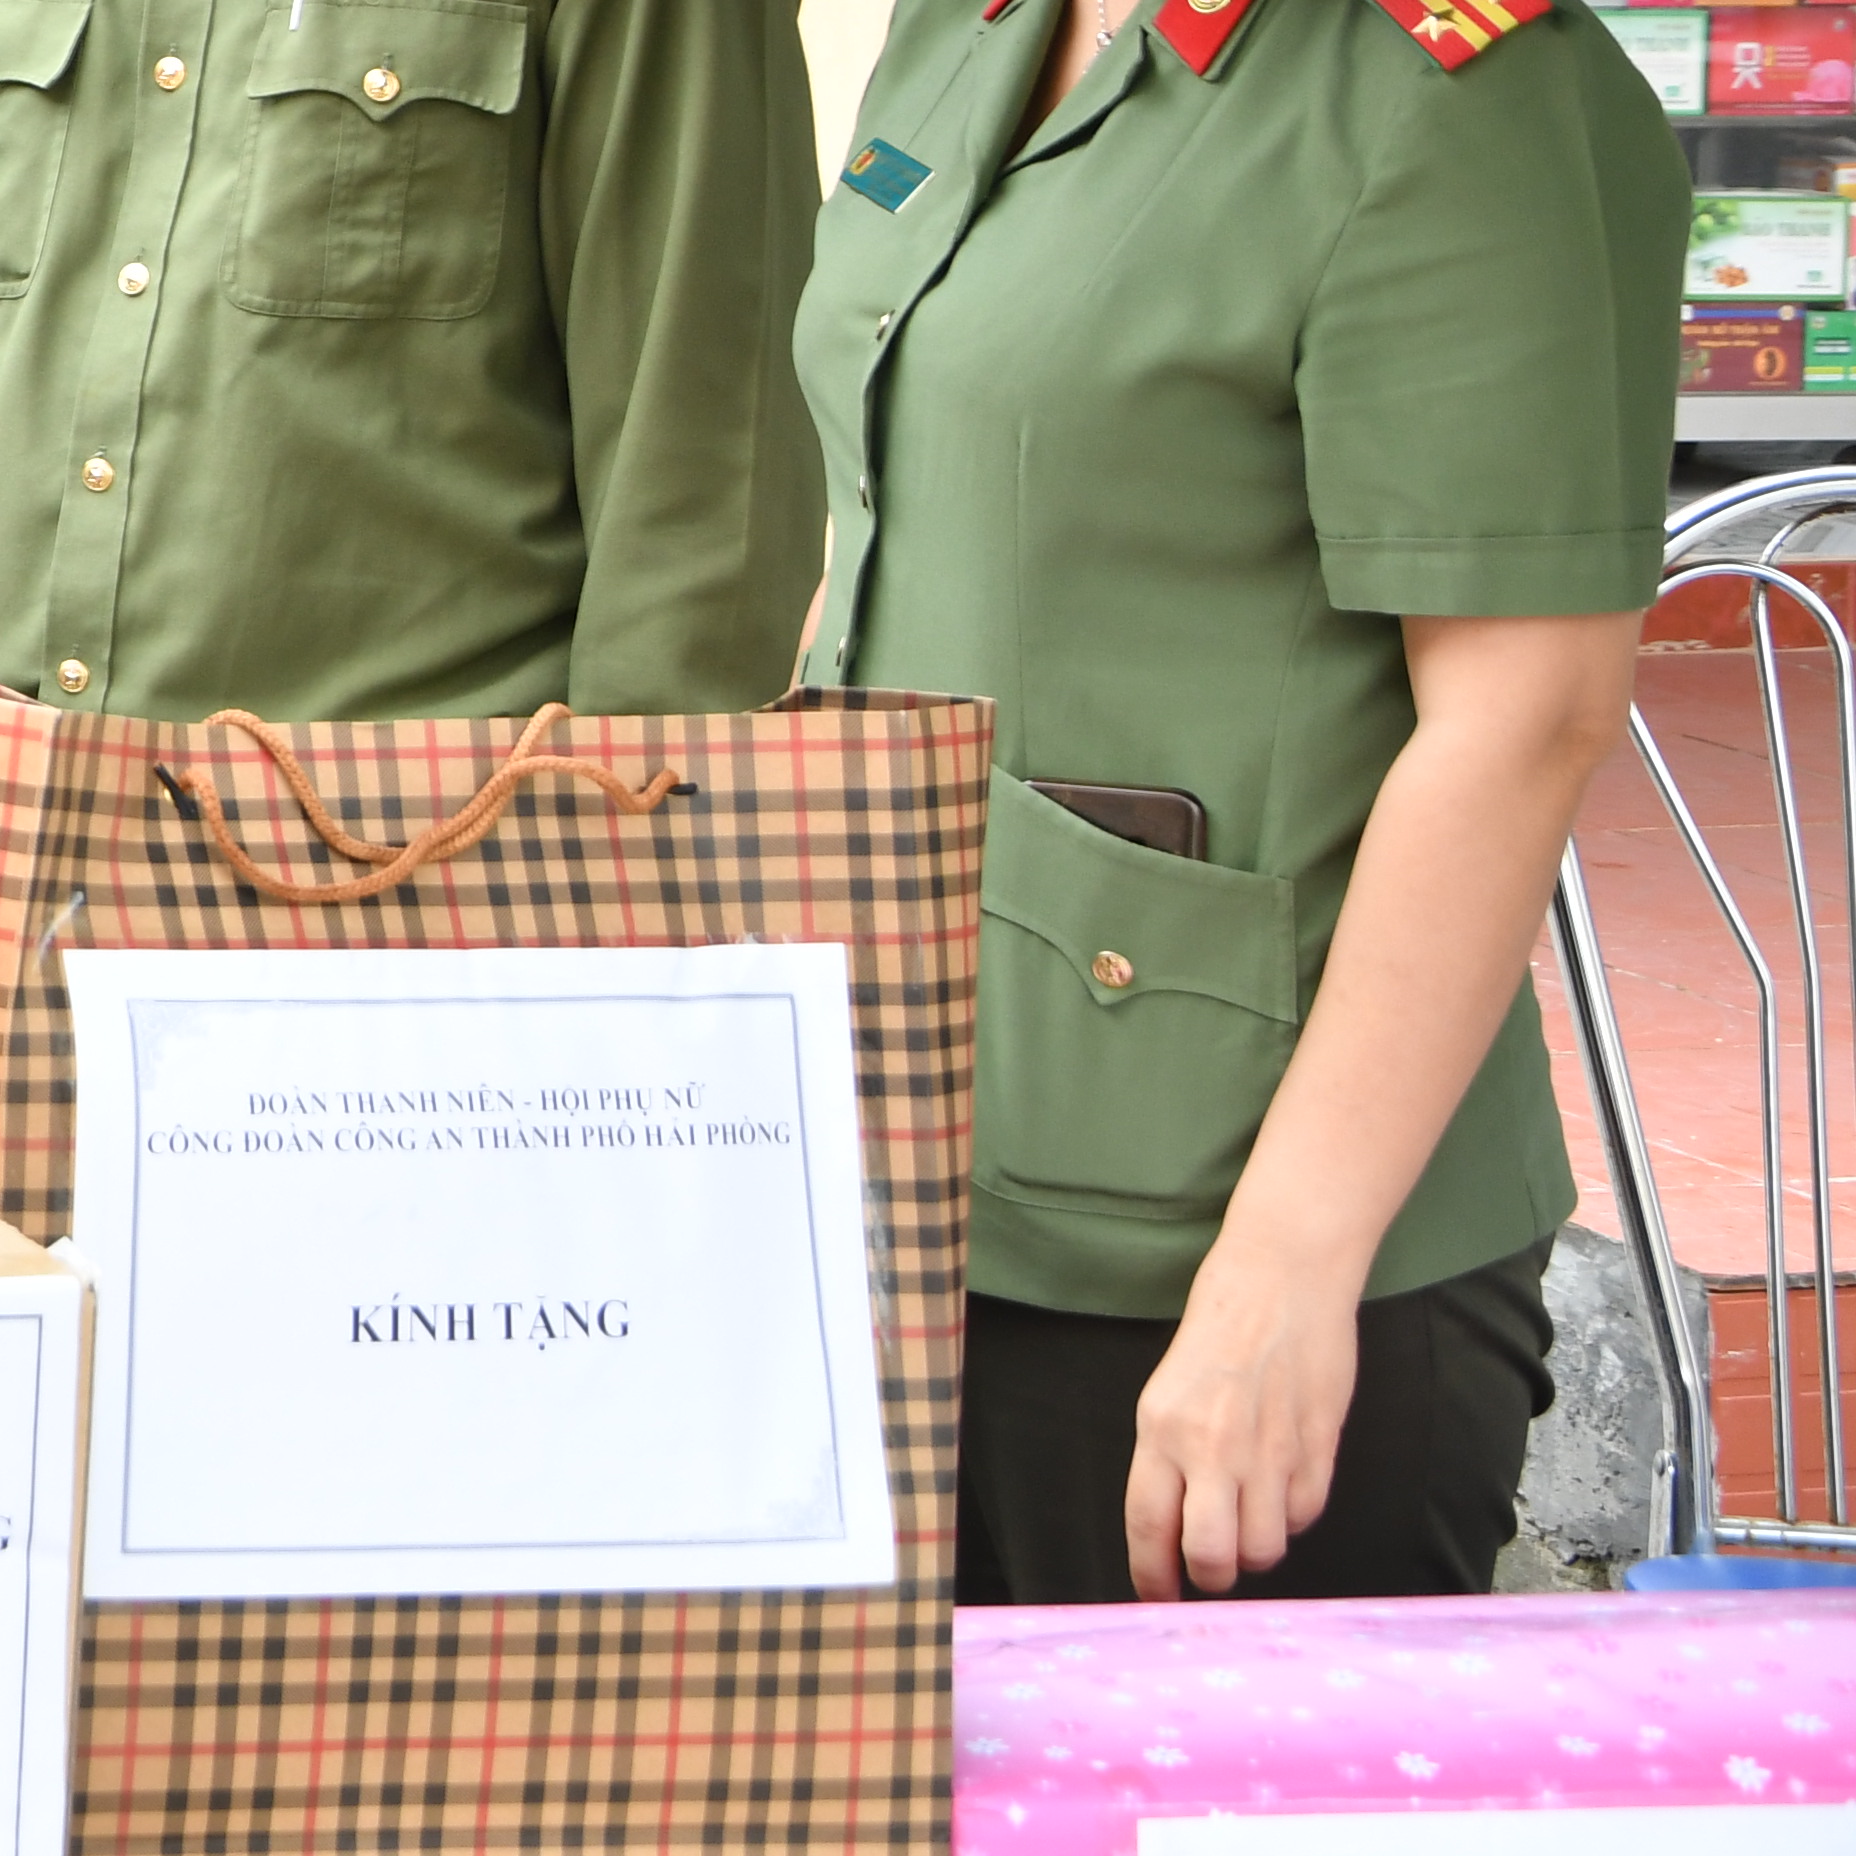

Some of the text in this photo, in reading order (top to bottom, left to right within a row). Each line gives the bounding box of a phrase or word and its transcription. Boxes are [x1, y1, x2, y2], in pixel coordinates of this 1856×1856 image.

[249, 1087, 327, 1115] ĐOÀN
[342, 1091, 438, 1114] THANH
[447, 1084, 514, 1113] NIÊN
[540, 1087, 590, 1117] HỘI
[598, 1088, 651, 1117] PHỤ
[664, 1081, 706, 1110] NỮ
[147, 1124, 232, 1154] CÔNG
[244, 1124, 324, 1153] ĐOÀN
[334, 1121, 416, 1152] CÔNG
[426, 1128, 463, 1150] AN
[477, 1122, 570, 1149] THÀNH
[707, 1116, 792, 1146] PHÒNG
[350, 1292, 630, 1352] KÍNH TẶNG
